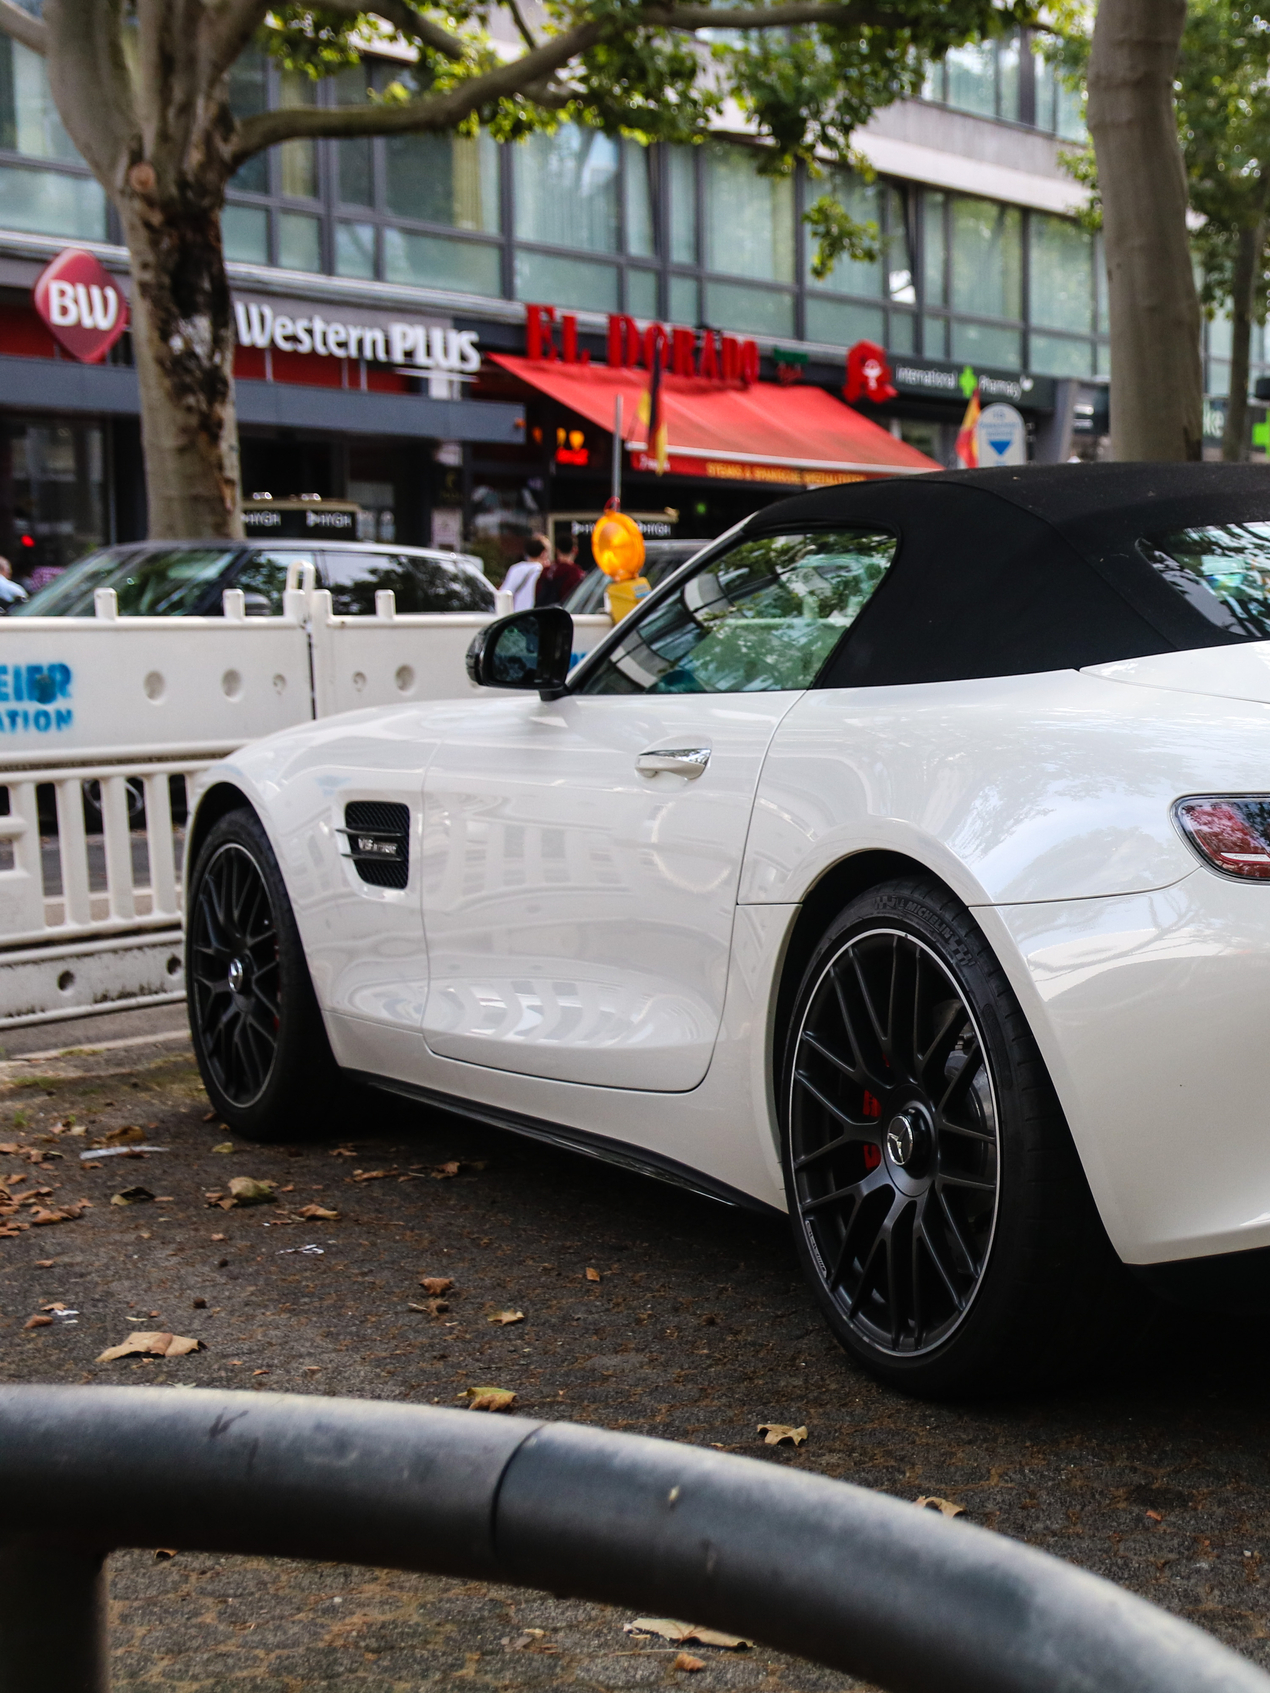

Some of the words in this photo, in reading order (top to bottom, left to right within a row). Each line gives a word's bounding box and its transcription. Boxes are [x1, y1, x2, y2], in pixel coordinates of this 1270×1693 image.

[50, 280, 118, 331] BW
[234, 301, 388, 363] Western
[388, 321, 482, 373] PLUS
[896, 364, 959, 391] International
[905, 900, 955, 940] MICHELIN
